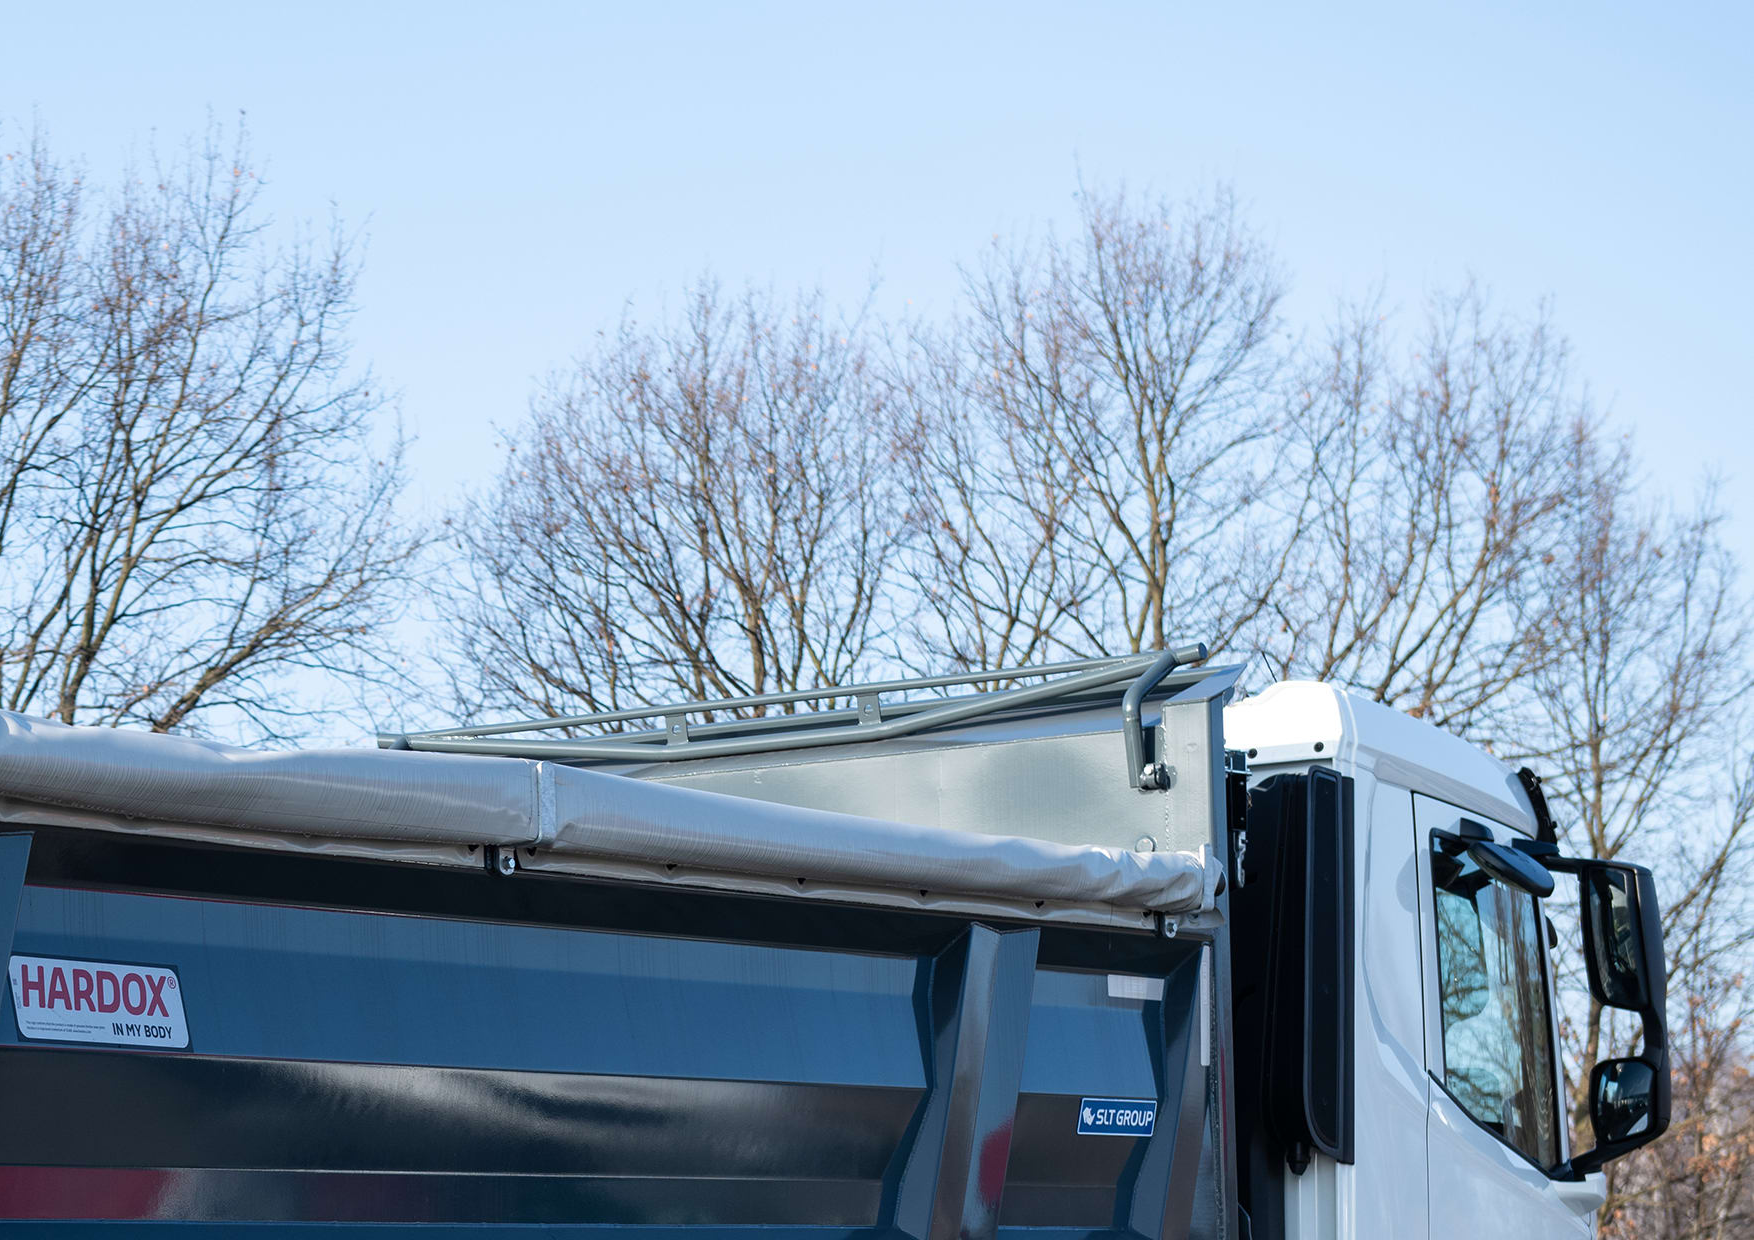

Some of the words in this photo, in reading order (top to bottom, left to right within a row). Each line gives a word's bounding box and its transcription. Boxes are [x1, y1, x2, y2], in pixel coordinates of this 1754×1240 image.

[112, 1022, 124, 1036] IN
[126, 1023, 143, 1037] MY
[145, 1025, 172, 1039] BODY
[1095, 1109, 1116, 1125] SLT
[1116, 1110, 1154, 1127] GROUP
